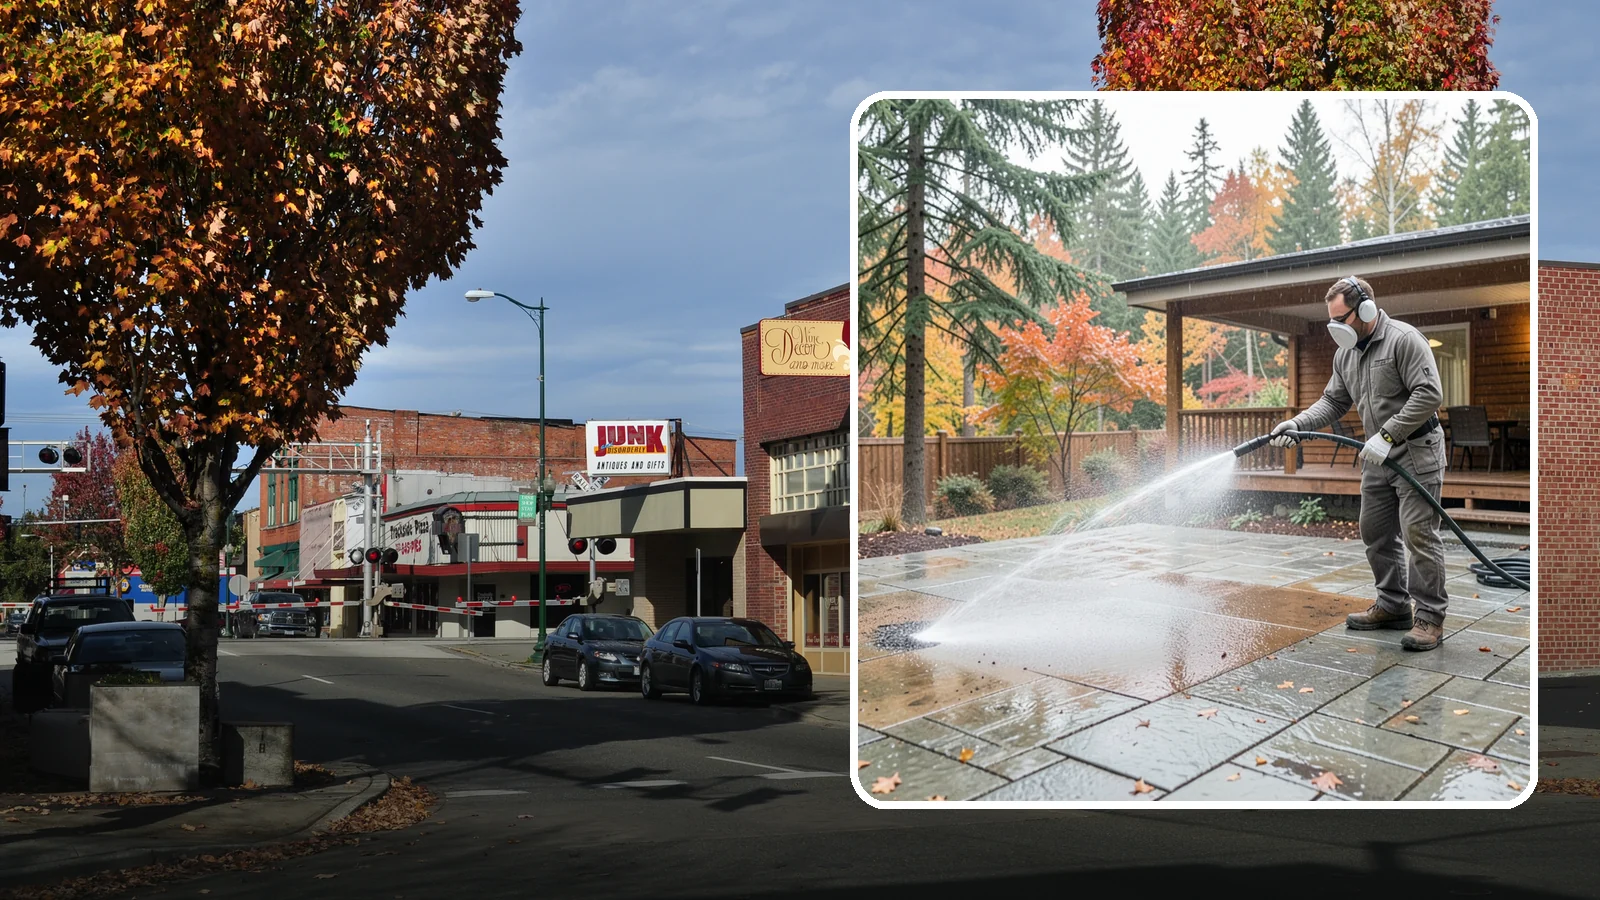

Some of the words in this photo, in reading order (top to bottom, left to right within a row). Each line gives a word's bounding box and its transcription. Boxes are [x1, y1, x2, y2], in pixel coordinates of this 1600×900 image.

[765, 327, 830, 365] Decor
[595, 425, 664, 456] JUNK
[607, 446, 645, 454] DISORDERLY
[596, 461, 627, 470] ANTIQUES
[631, 460, 643, 469] AND
[646, 461, 664, 469] GIFTS
[390, 521, 412, 539] Trackside
[414, 519, 428, 534] Pizza
